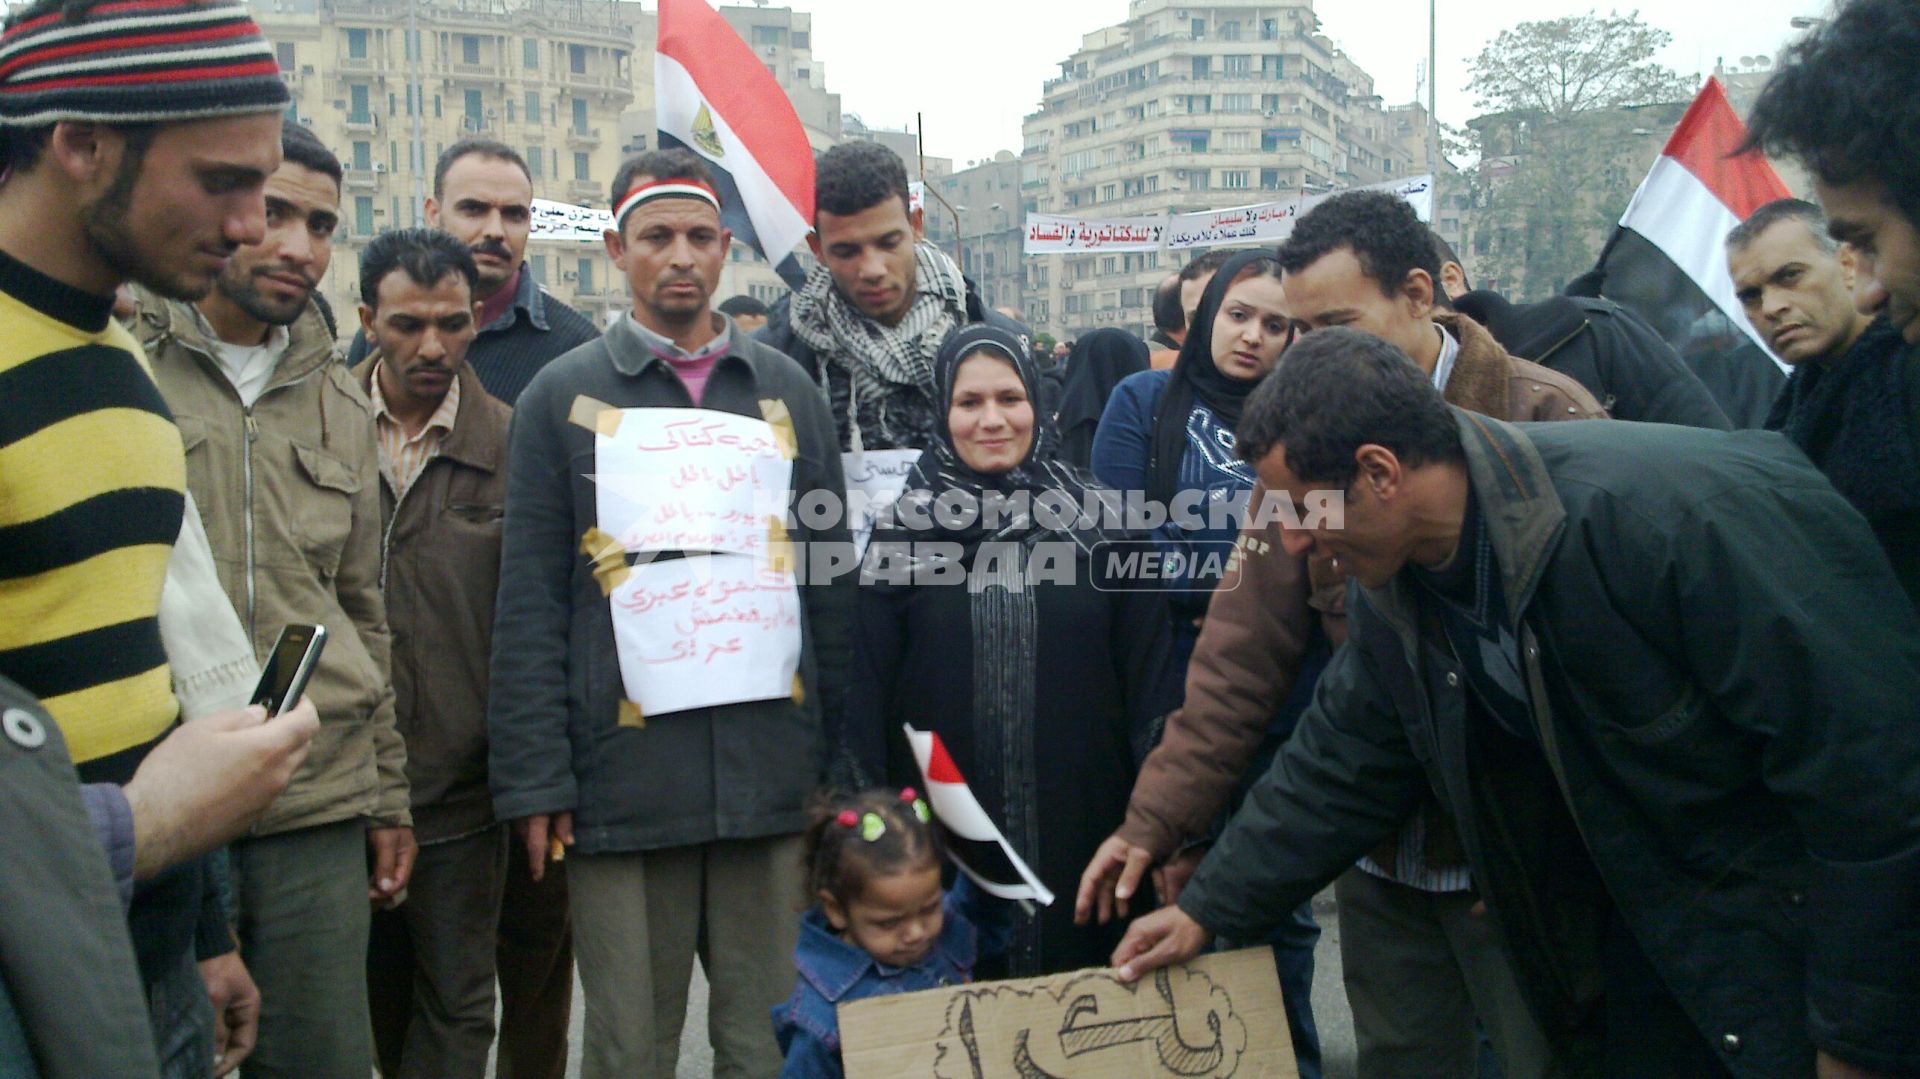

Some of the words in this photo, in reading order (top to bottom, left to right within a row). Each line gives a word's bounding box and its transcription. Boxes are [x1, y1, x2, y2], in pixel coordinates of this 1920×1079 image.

[1258, 208, 1287, 222] مبارك
[1288, 204, 1297, 217] لا
[1210, 212, 1243, 229] سليمان
[1029, 222, 1075, 247] والفساد
[1152, 224, 1163, 242] لا
